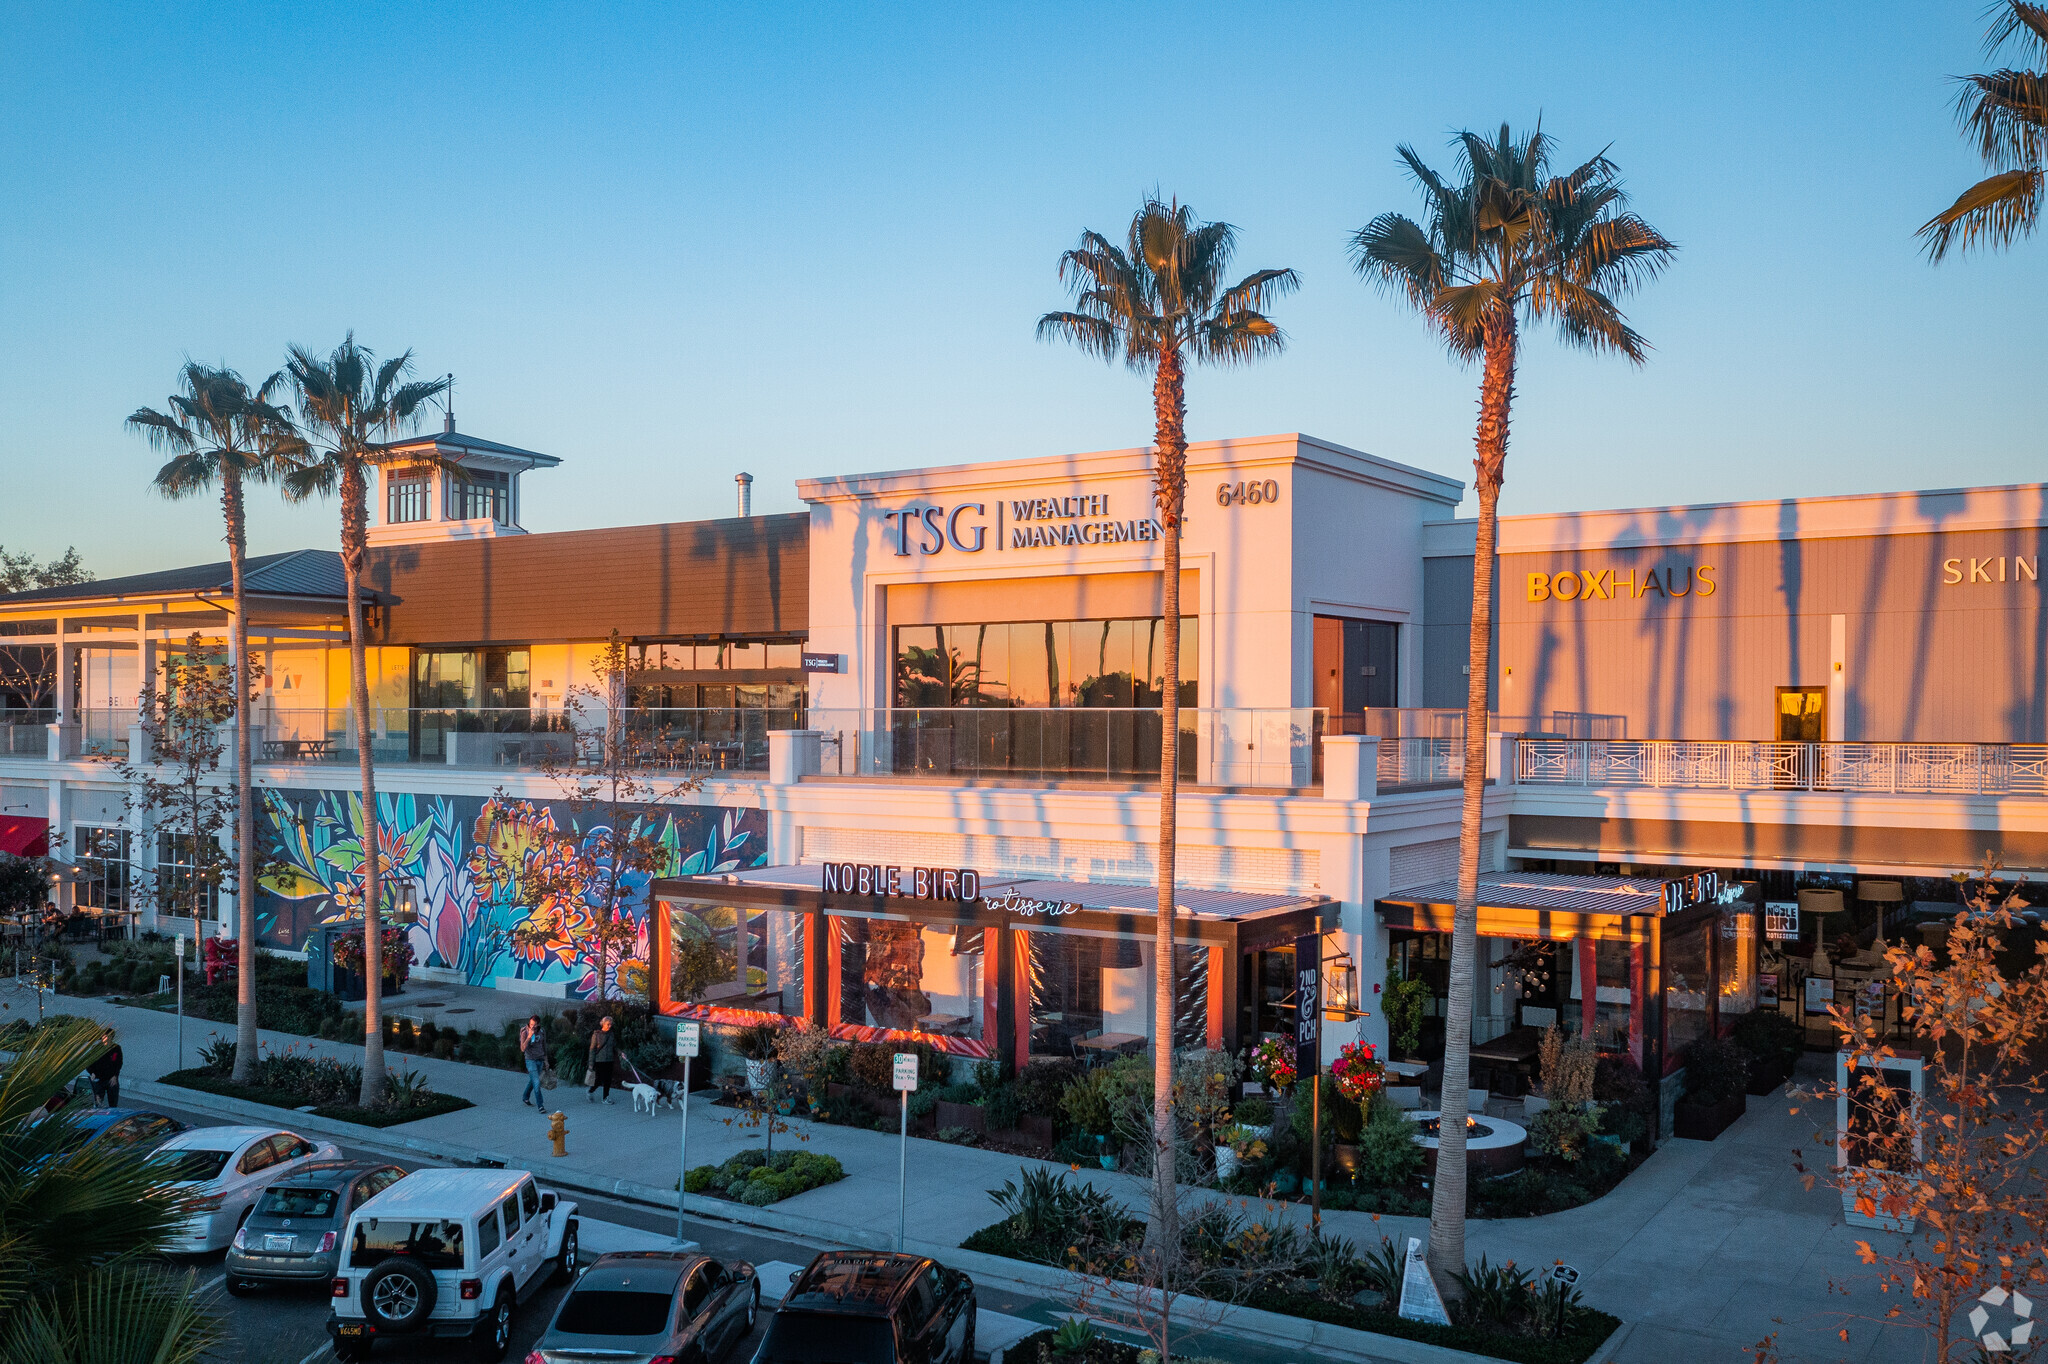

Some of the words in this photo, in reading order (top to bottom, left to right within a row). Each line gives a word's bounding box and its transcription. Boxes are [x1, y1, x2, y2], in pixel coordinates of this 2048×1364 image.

[1215, 479, 1280, 506] 6460
[1009, 494, 1109, 520] WEALTH
[884, 503, 988, 556] TSG
[1943, 555, 2038, 584] SKIN
[1527, 565, 1717, 601] BOXHAUS
[805, 658, 816, 667] TSG
[823, 862, 901, 897] NOBLE
[913, 866, 980, 902] BIRD
[983, 888, 1080, 917] rotisserie
[1767, 905, 1797, 917] NOBLE
[1767, 916, 1797, 930] BIRD
[1766, 932, 1799, 940] ROTISSERIE
[1299, 968, 1317, 991] 2ND
[1301, 985, 1317, 1020] &
[1299, 1018, 1317, 1042] PCH
[894, 1054, 903, 1063] 30
